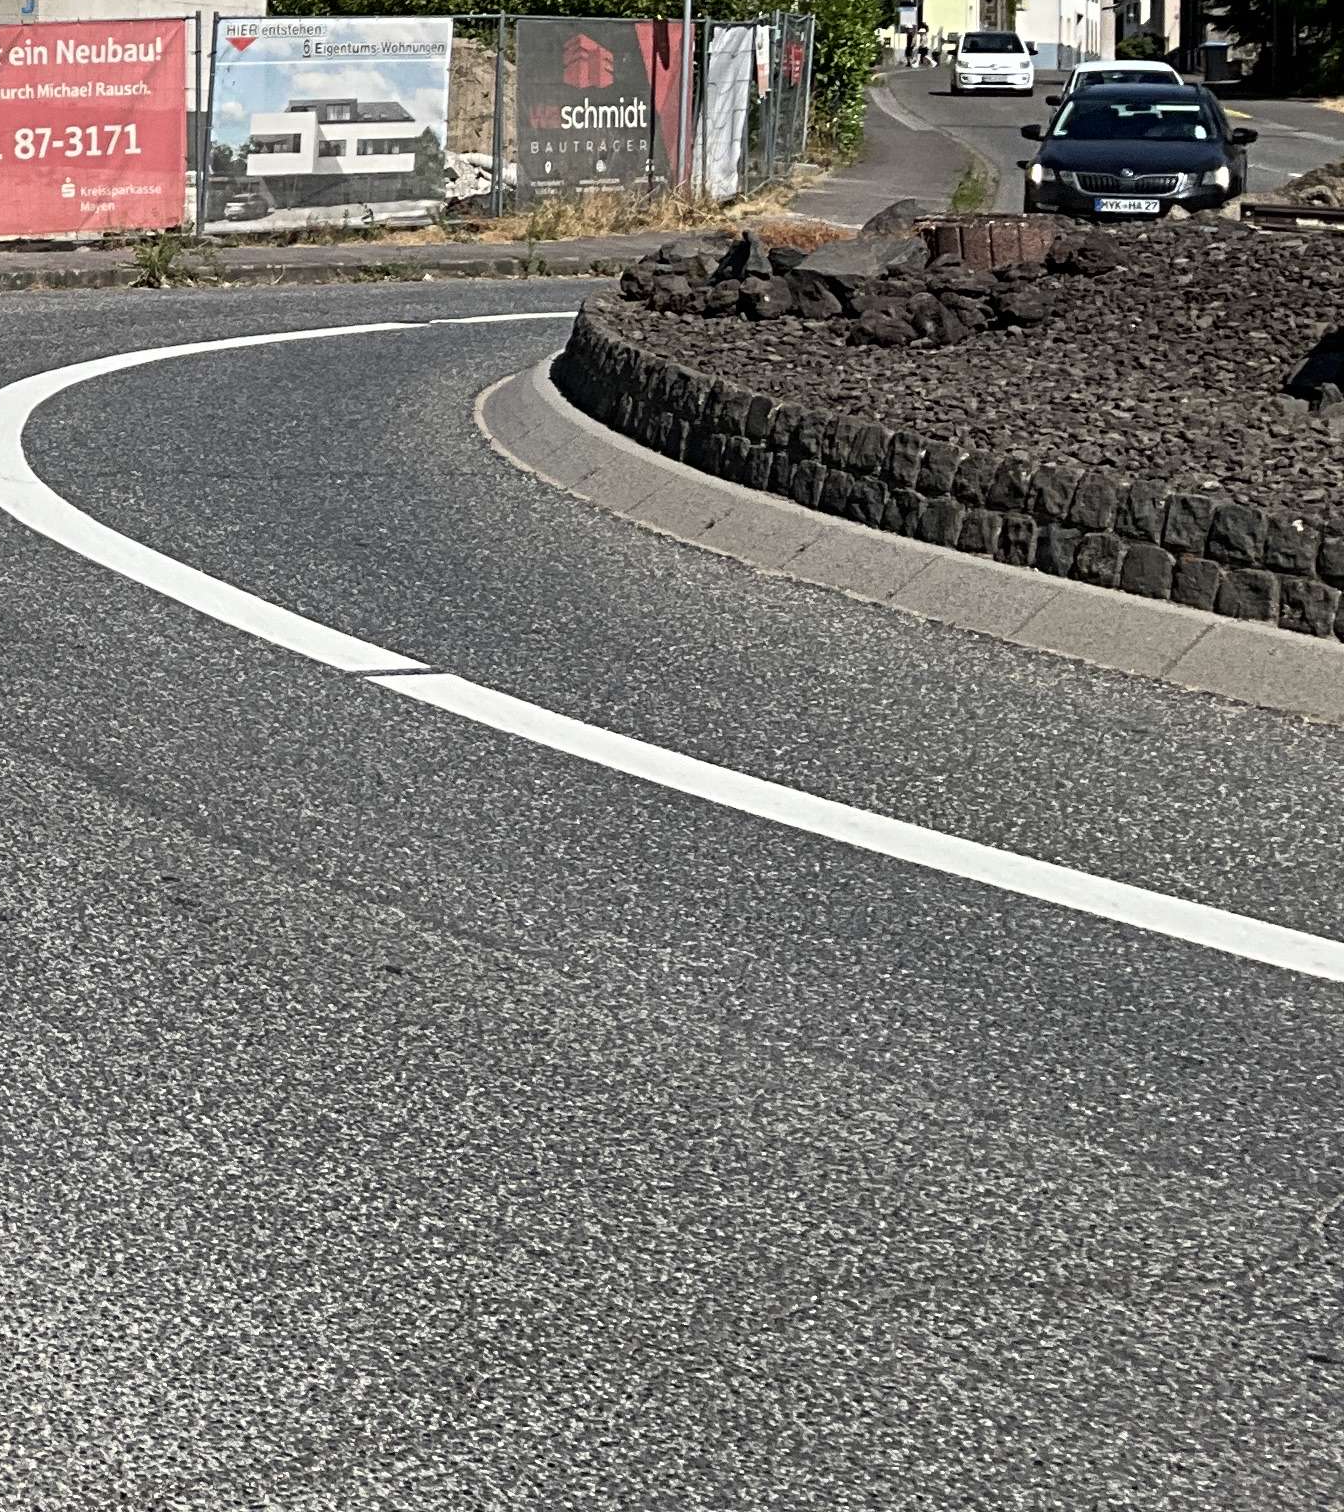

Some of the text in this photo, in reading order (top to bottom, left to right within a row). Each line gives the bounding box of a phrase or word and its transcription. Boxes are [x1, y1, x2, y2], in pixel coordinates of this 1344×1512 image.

[225, 24, 258, 37] HIER
[8, 39, 48, 65] ein
[55, 37, 162, 65] Neubau!
[36, 81, 92, 98] Michael
[95, 80, 152, 97] Rausch.
[560, 96, 648, 129] schmidt
[14, 122, 142, 158] 87-3171
[80, 200, 116, 214] Mayen
[1144, 200, 1159, 210] 27
